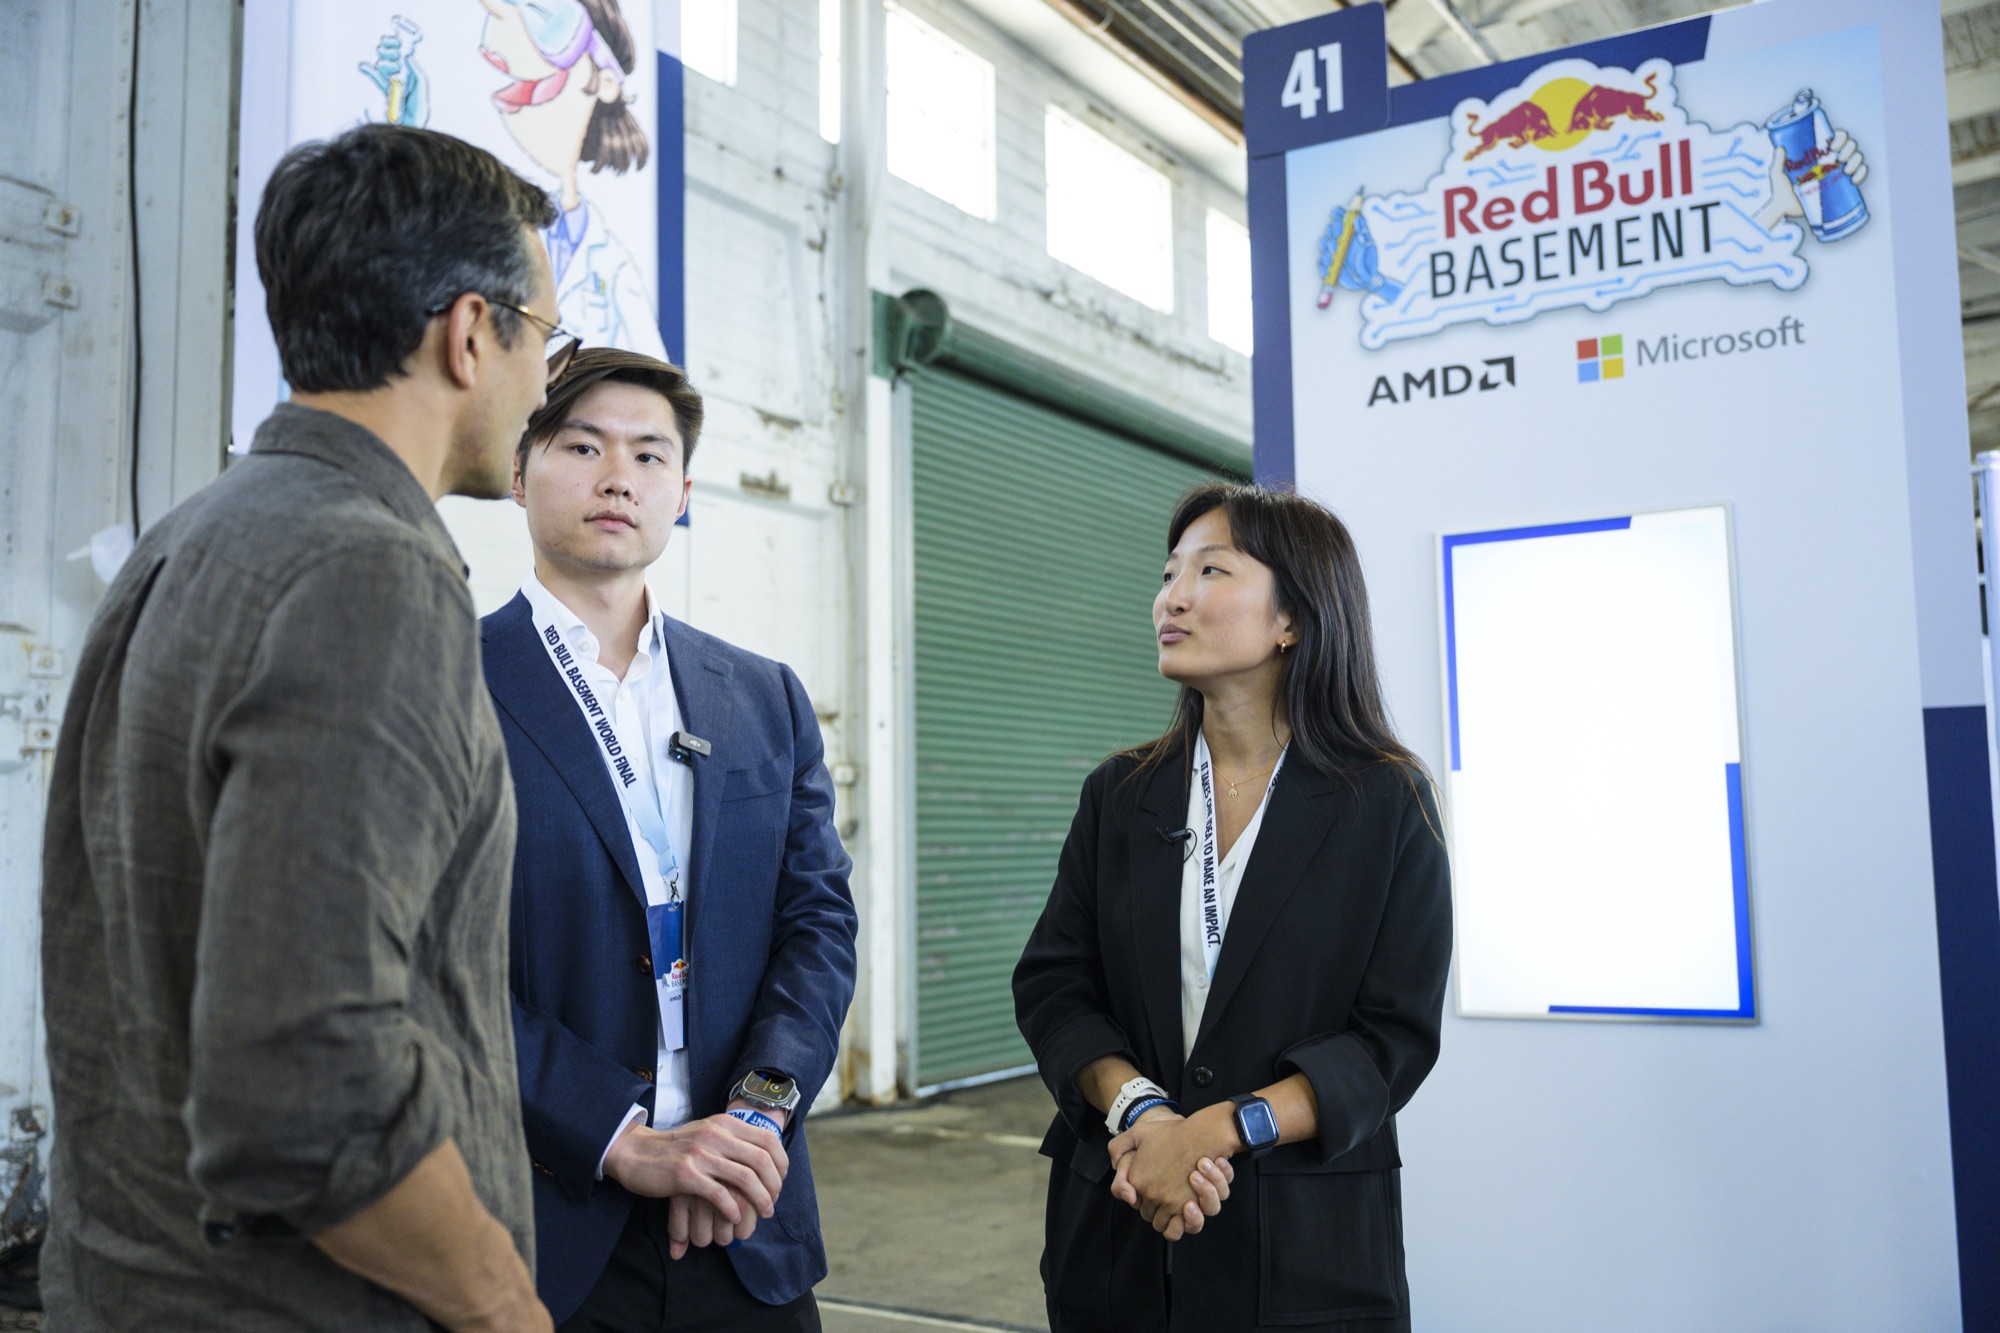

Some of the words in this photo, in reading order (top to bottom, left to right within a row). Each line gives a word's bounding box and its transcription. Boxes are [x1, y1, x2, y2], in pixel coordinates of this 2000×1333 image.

[1281, 42, 1344, 120] 41
[1445, 165, 1560, 240] Red
[1572, 139, 1694, 216] Bull
[1428, 201, 1722, 299] BASEMENT
[1636, 316, 1806, 367] Microsoft
[1367, 363, 1474, 407] AMD
[543, 624, 560, 647] RED
[553, 643, 574, 669] BULL
[566, 666, 605, 718] BASEMENT
[594, 717, 622, 757] WORLD
[613, 756, 637, 789] FINAL
[1200, 761, 1209, 772] IT
[1201, 770, 1211, 798] TAKES
[1203, 839, 1214, 855] TO
[1204, 858, 1215, 886] MAKE
[1204, 888, 1216, 904] AN
[1205, 905, 1222, 948] IMPACT.
